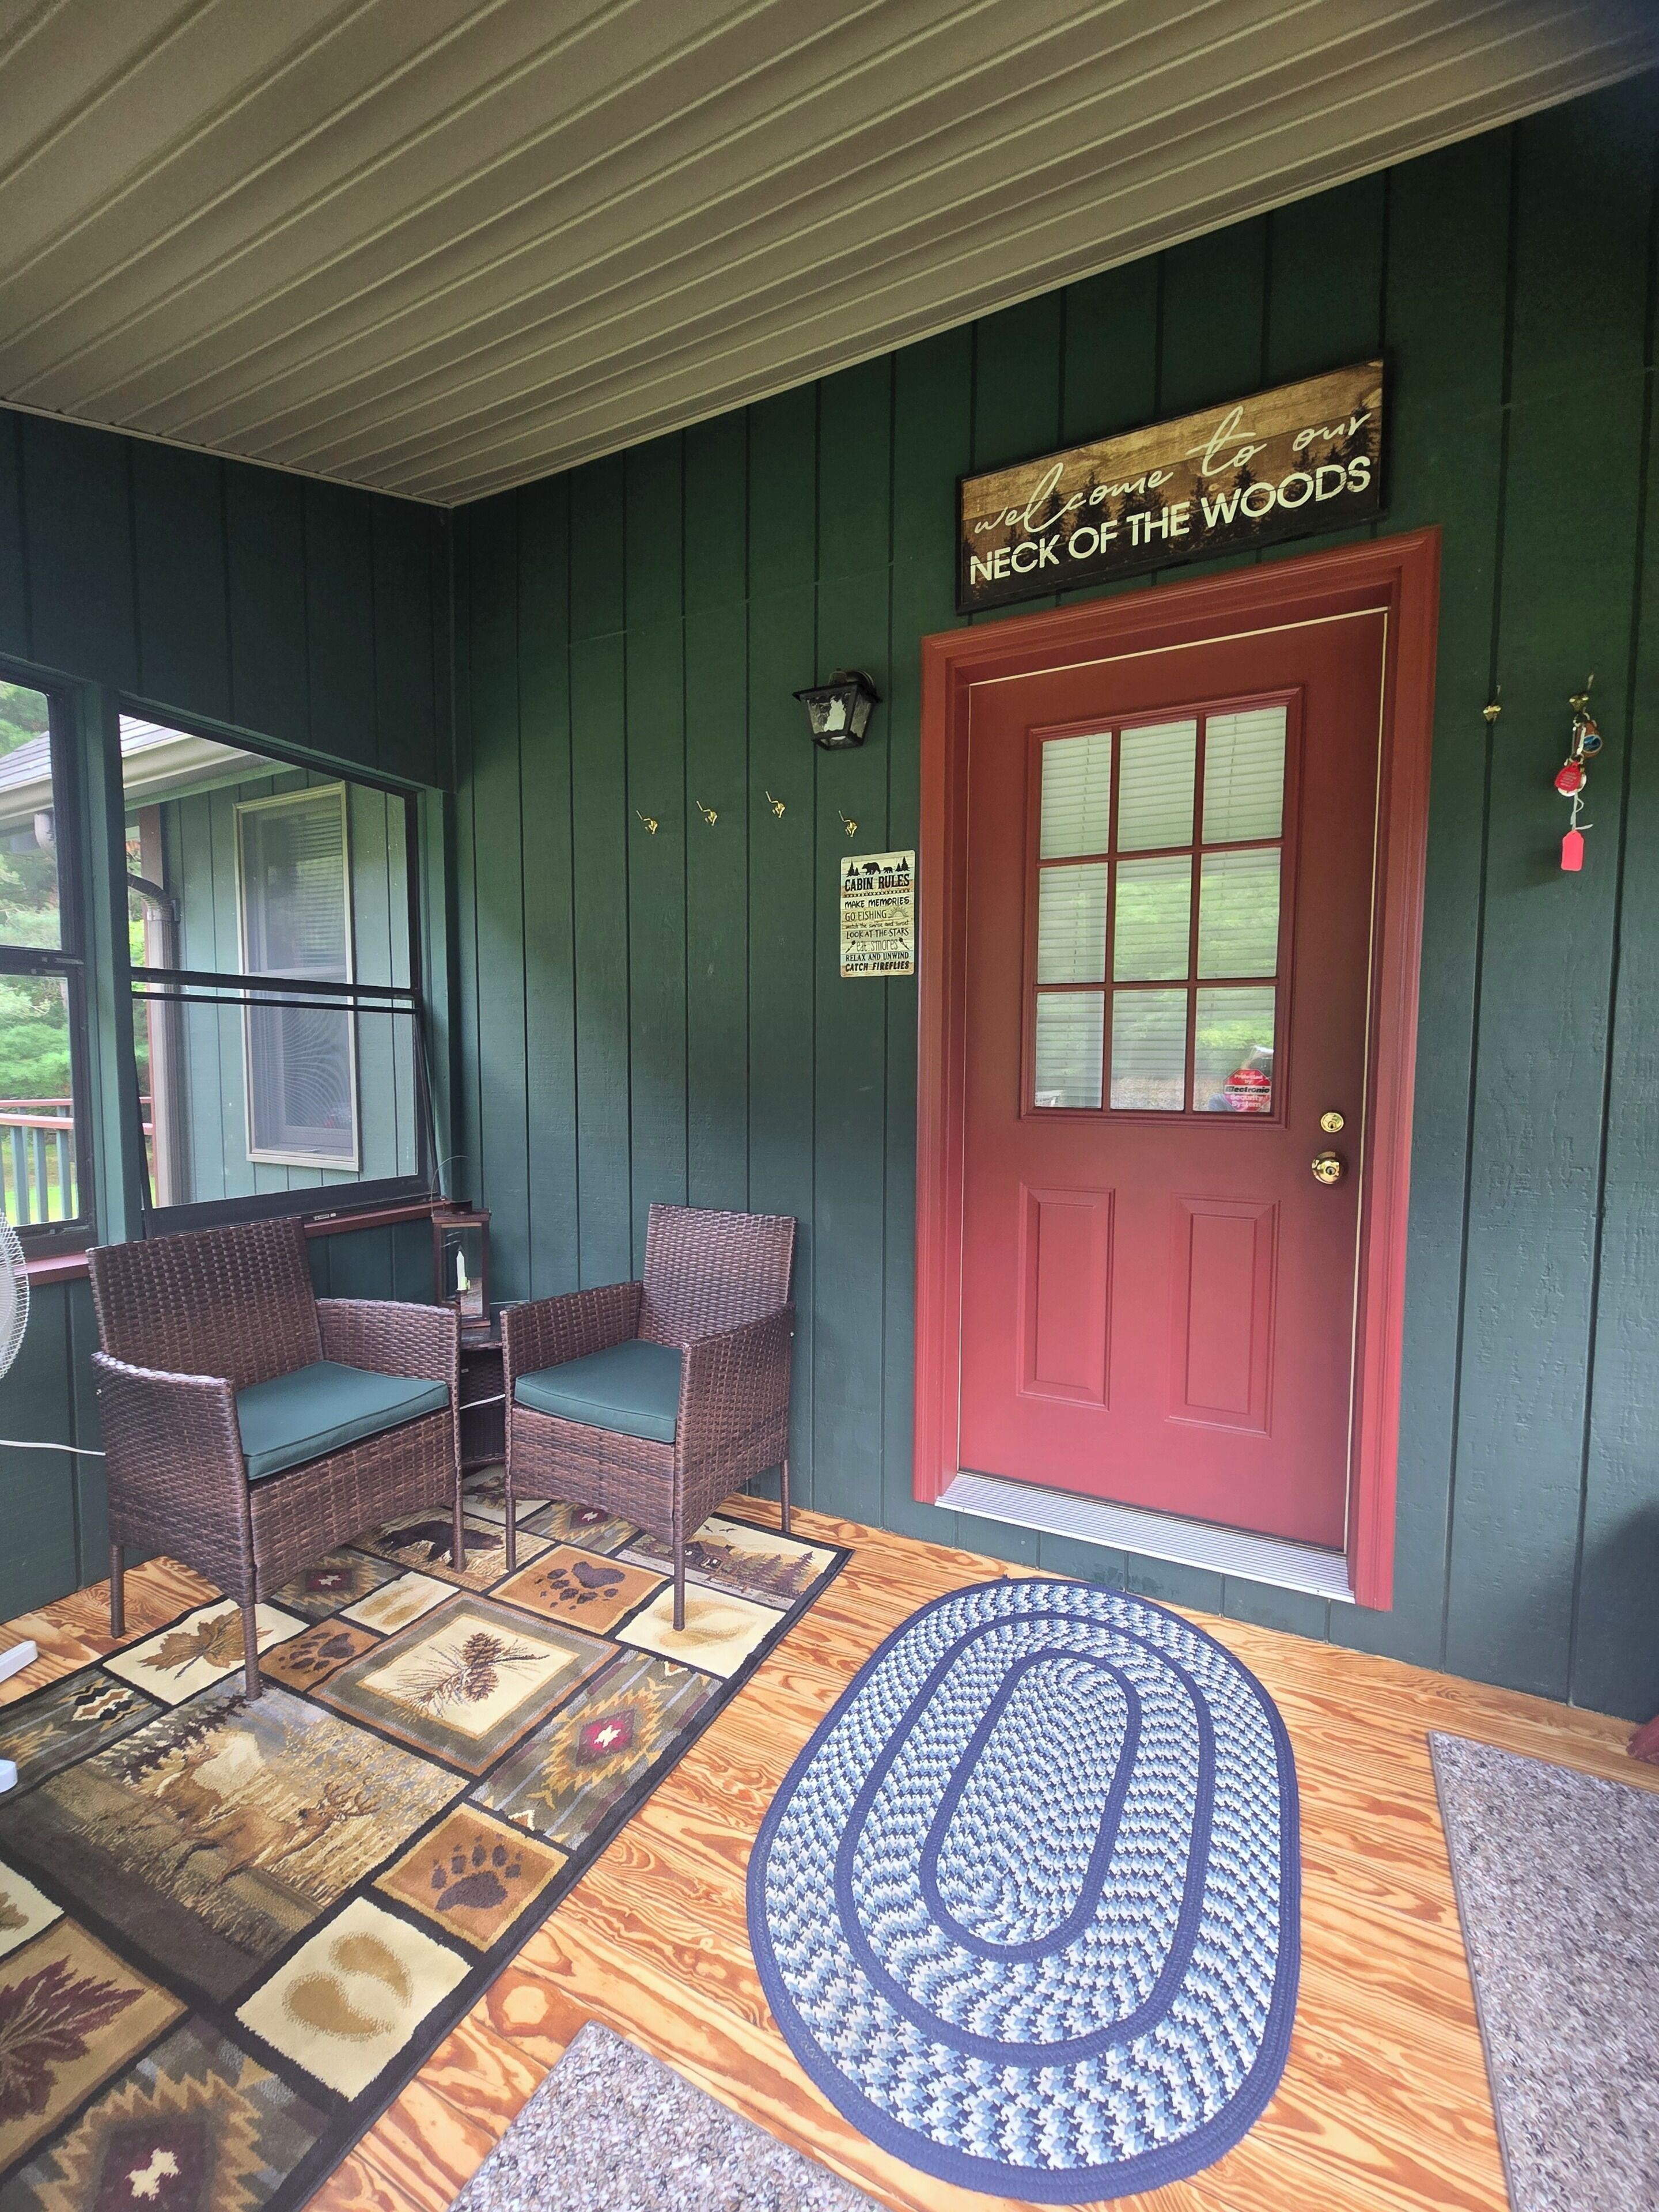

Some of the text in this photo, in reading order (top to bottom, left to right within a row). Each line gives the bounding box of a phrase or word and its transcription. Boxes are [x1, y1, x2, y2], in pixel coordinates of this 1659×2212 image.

[974, 406, 1372, 535] welcome to our
[970, 455, 1371, 585] NECK OF THE WOODS
[845, 873, 910, 892] CABIN RULES
[845, 896, 910, 908] MAKE MEMORIES
[845, 910, 887, 921] GO FISHING
[846, 927, 909, 940] LOOK AT THE STARS
[857, 941, 867, 952] eat
[846, 961, 910, 972] CATCH FIREFLIES
